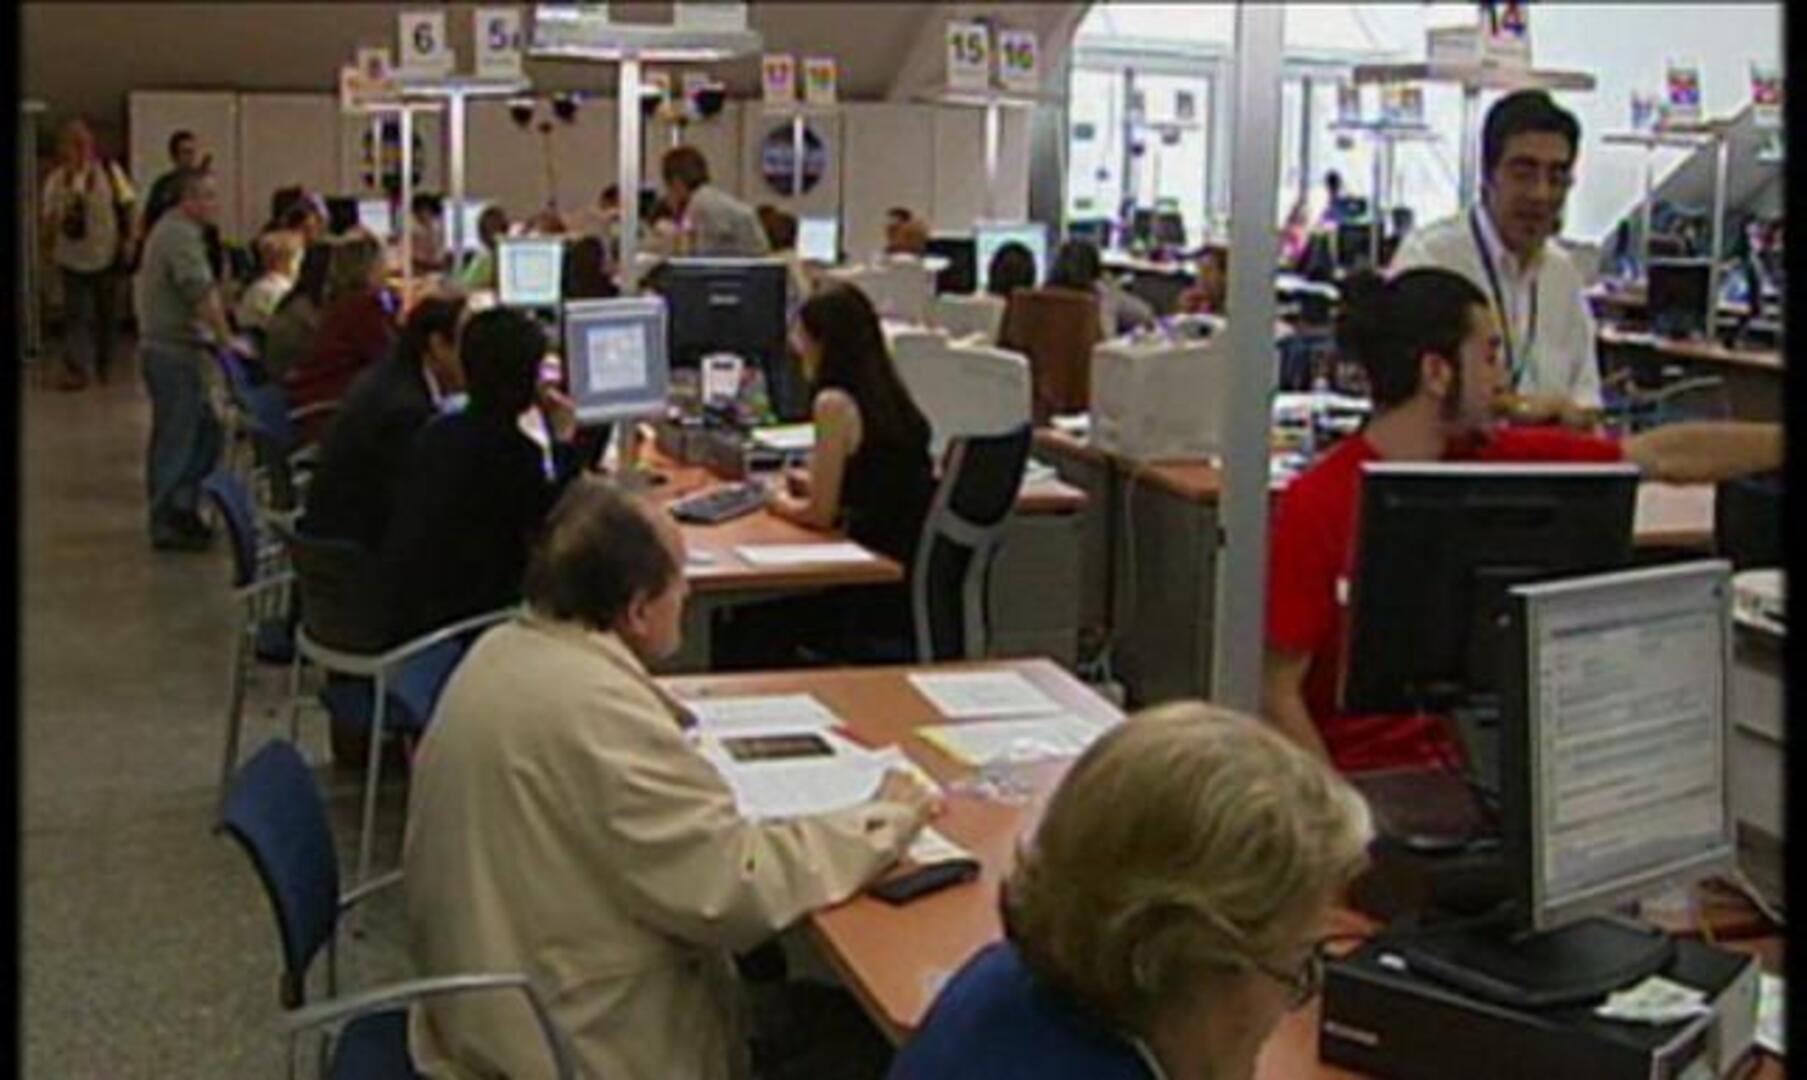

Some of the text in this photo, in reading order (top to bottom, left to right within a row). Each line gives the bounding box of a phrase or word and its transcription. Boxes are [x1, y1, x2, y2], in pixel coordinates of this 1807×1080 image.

[413, 22, 434, 54] 6
[489, 18, 508, 49] 5
[952, 31, 986, 65] 15
